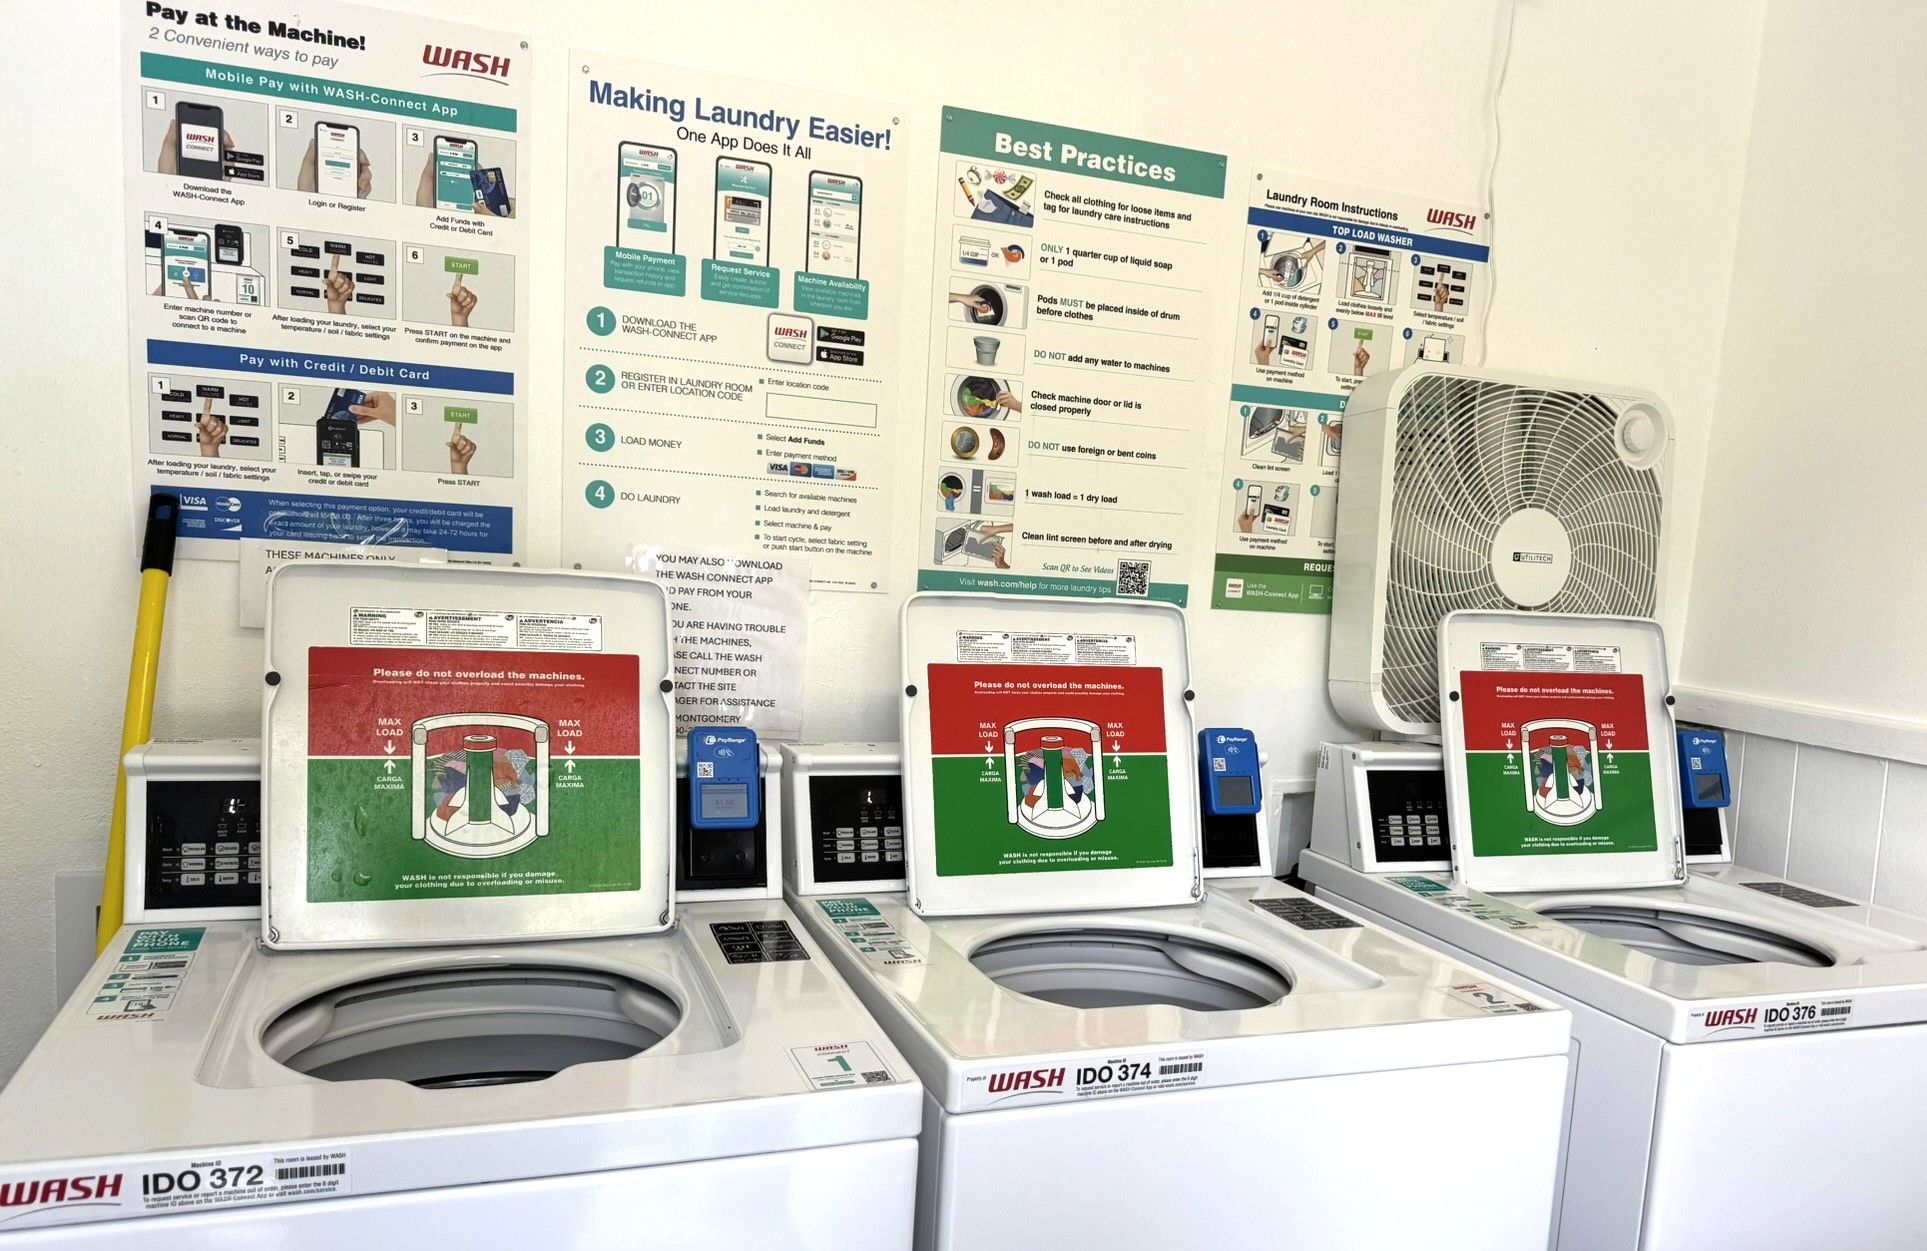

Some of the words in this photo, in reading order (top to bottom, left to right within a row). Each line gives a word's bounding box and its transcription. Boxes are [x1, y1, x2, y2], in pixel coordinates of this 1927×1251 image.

[146, 0, 188, 25] Pay
[195, 11, 217, 27] at
[224, 14, 261, 33] the
[268, 20, 365, 50] Machine!
[148, 26, 159, 39] 2
[164, 28, 249, 53] Convenient
[253, 45, 289, 61] ways
[294, 49, 308, 62] to
[311, 54, 338, 69] pay
[422, 44, 510, 78] WASH
[205, 67, 253, 84] Mobile
[259, 75, 283, 91] Pay
[289, 82, 318, 94] with
[323, 85, 426, 110] WASH-Connect
[431, 102, 457, 117] App
[589, 80, 684, 122] Making
[695, 97, 800, 140] Laundry
[809, 116, 890, 150] Easier!
[676, 126, 706, 143] One
[710, 131, 738, 150] App
[743, 136, 778, 154] Does
[783, 142, 790, 156] It
[794, 145, 811, 159] All
[995, 132, 1052, 161] Best
[1060, 143, 1175, 181] Practices
[308, 198, 327, 207] Login
[337, 202, 365, 211] Register
[1044, 190, 1069, 202] Check
[1071, 195, 1081, 203] all
[1083, 196, 1115, 211] clothing
[1117, 201, 1129, 211] for
[1130, 204, 1152, 215] loose
[1153, 207, 1175, 218] items
[1176, 213, 1191, 221] and
[1266, 188, 1307, 207] Laundry
[1310, 196, 1338, 210] Room
[1341, 201, 1397, 220] Instructions
[1043, 202, 1056, 213] tag
[1058, 204, 1069, 213] for
[1071, 206, 1102, 220] laundry
[1104, 213, 1121, 221] care
[1123, 214, 1169, 229] instructions
[1426, 208, 1476, 229] WASH
[1332, 225, 1350, 235] TOP
[1351, 228, 1375, 240] LOAD
[1377, 232, 1412, 246] WASHER
[451, 261, 470, 269] START
[615, 250, 640, 260] Mobile
[642, 254, 675, 265] Payment
[1040, 243, 1063, 253] ONLY
[1066, 246, 1069, 254] 1
[1072, 249, 1101, 259] quarter
[1103, 253, 1118, 263] cup
[1119, 255, 1128, 263] of
[1130, 255, 1152, 267] liquid
[1153, 261, 1172, 271] soap
[1051, 256, 1054, 264] 1
[1057, 258, 1073, 267] pod
[711, 263, 741, 275] Request
[743, 267, 770, 277] Service
[797, 275, 827, 286] Machine
[828, 279, 865, 292] Availability
[597, 313, 604, 327] 1
[622, 315, 676, 329] DOWNLOAD
[679, 321, 696, 331] THE
[621, 324, 696, 340] WASH-CONNECT
[699, 333, 717, 342] APP
[774, 327, 807, 340] WASH
[773, 341, 805, 350] CONNECT
[239, 353, 263, 367] Pay
[269, 357, 297, 368] with
[303, 359, 345, 372] Credit
[349, 363, 354, 373] /
[359, 364, 394, 376] Debit
[399, 368, 429, 379] Card
[595, 370, 605, 385] 2
[621, 371, 665, 386] REGISTER
[668, 376, 677, 387] IN
[680, 377, 722, 389] LAUNDRY
[724, 382, 752, 392] ROOM
[621, 381, 635, 389] OR
[637, 382, 667, 392] ENTER
[669, 385, 715, 398] LOCATION
[716, 390, 742, 401] CODE
[450, 411, 471, 419] START
[595, 428, 605, 443] 3
[620, 435, 646, 445] LOAD
[648, 438, 681, 448] MONEY
[769, 463, 787, 471] VISA
[437, 477, 456, 485] Press
[594, 486, 605, 500] 4
[620, 492, 635, 501] DO
[637, 493, 680, 504] LAUNDRY
[1021, 531, 1044, 540] Clean
[1046, 533, 1058, 541] lint
[1060, 535, 1086, 543] screen
[1088, 536, 1112, 545] before
[1113, 538, 1128, 546] and
[1129, 539, 1147, 547] after
[1148, 540, 1172, 550] drying
[656, 554, 676, 563] YOU
[678, 555, 698, 564] MAY
[699, 556, 724, 566] ALSO
[655, 569, 673, 579] THE
[675, 570, 704, 580] WASH
[706, 573, 753, 583] CONNECT
[754, 576, 772, 584] APP
[959, 577, 975, 585] Visit
[977, 578, 1037, 590] wash.com/help
[1038, 581, 1048, 589] for
[1070, 584, 1096, 593] laundry
[1098, 586, 1111, 594] tips
[685, 620, 704, 629] ARE
[706, 621, 742, 631] HAVING
[744, 623, 785, 633] TROUBLE
[700, 636, 751, 647] MACHINES,
[373, 668, 412, 678] Please
[415, 668, 429, 678] do
[433, 669, 452, 677] not
[455, 670, 504, 678] overload
[507, 670, 525, 678] the
[528, 671, 584, 680] machines.
[378, 717, 401, 725] MAX
[376, 728, 403, 736] LOAD
[1705, 1007, 1757, 1027] WASH
[1764, 1007, 1789, 1022] IDO
[1792, 1004, 1815, 1020] 376
[825, 1054, 851, 1071] 1
[988, 1067, 1065, 1093] WASH
[1076, 1065, 1112, 1087] IDO
[1117, 1062, 1151, 1083] 374
[142, 1170, 200, 1195] IDO
[210, 1164, 262, 1188] 372
[0, 1173, 122, 1207] WASH
